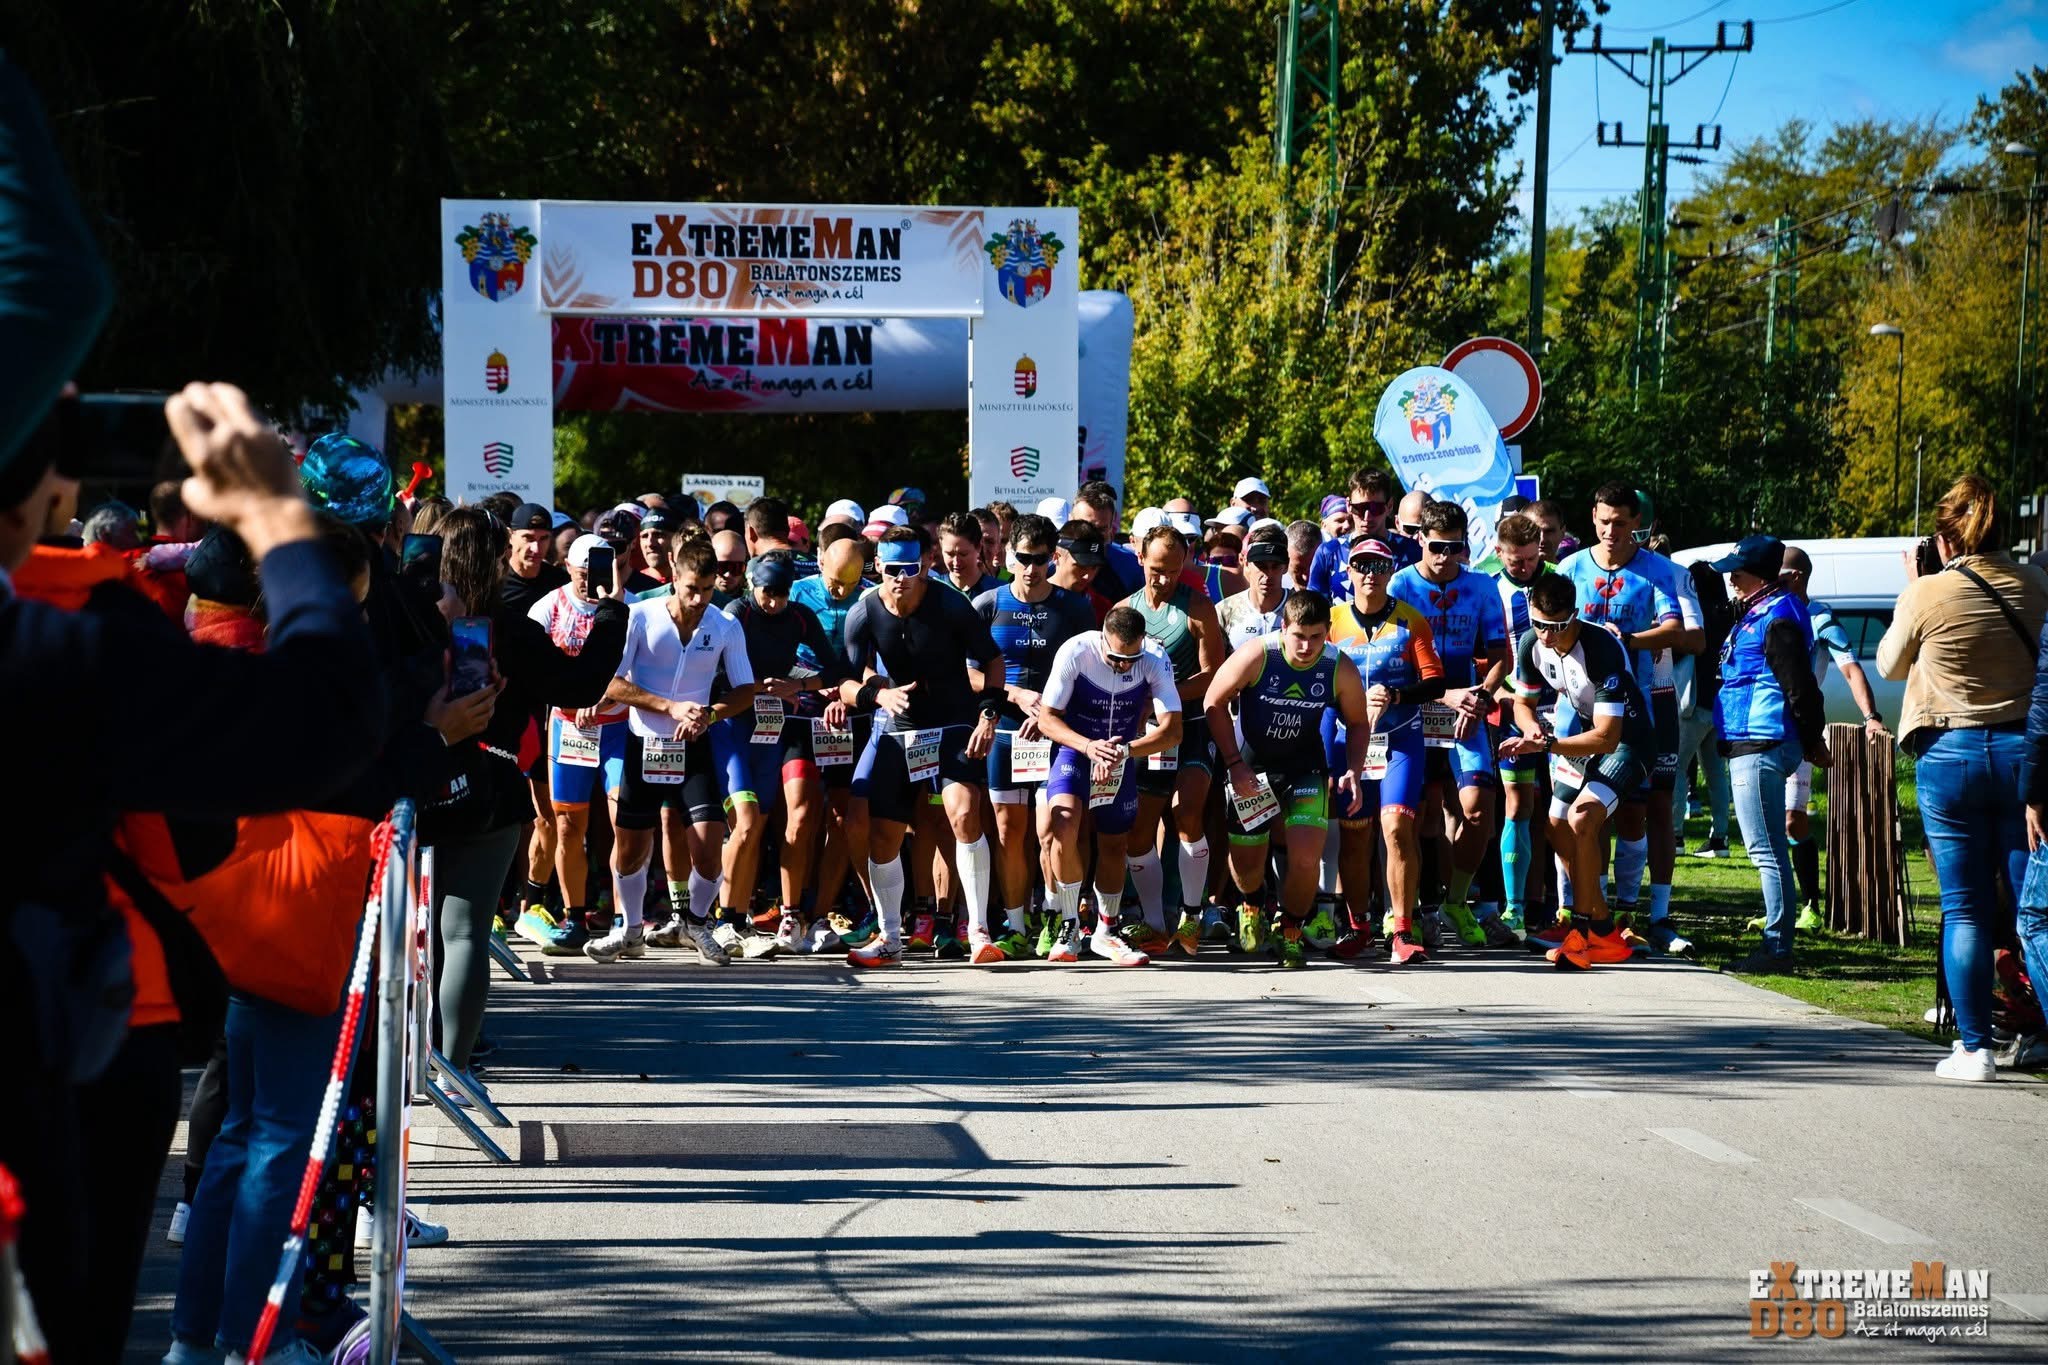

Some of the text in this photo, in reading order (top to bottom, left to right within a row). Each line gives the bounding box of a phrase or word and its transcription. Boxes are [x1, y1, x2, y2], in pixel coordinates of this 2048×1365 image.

[632, 215, 901, 261] EXTREMEMAN
[633, 260, 727, 299] D80
[751, 265, 901, 283] BALATONSZEMES
[751, 285, 864, 304] Az út maga a cél
[690, 370, 873, 398] Az út maga a cél
[994, 486, 1055, 495] BETHLEN GÁBOR
[1259, 694, 1326, 709] MERIDA
[757, 714, 784, 724] 80055
[1273, 711, 1302, 727] TOMA
[815, 734, 850, 744] 80084
[1266, 726, 1300, 740] HUN
[562, 738, 598, 751] 80048
[646, 753, 683, 763] 80010
[908, 746, 938, 760] 80013
[1014, 751, 1049, 760] 80068
[1237, 791, 1272, 812] 80093
